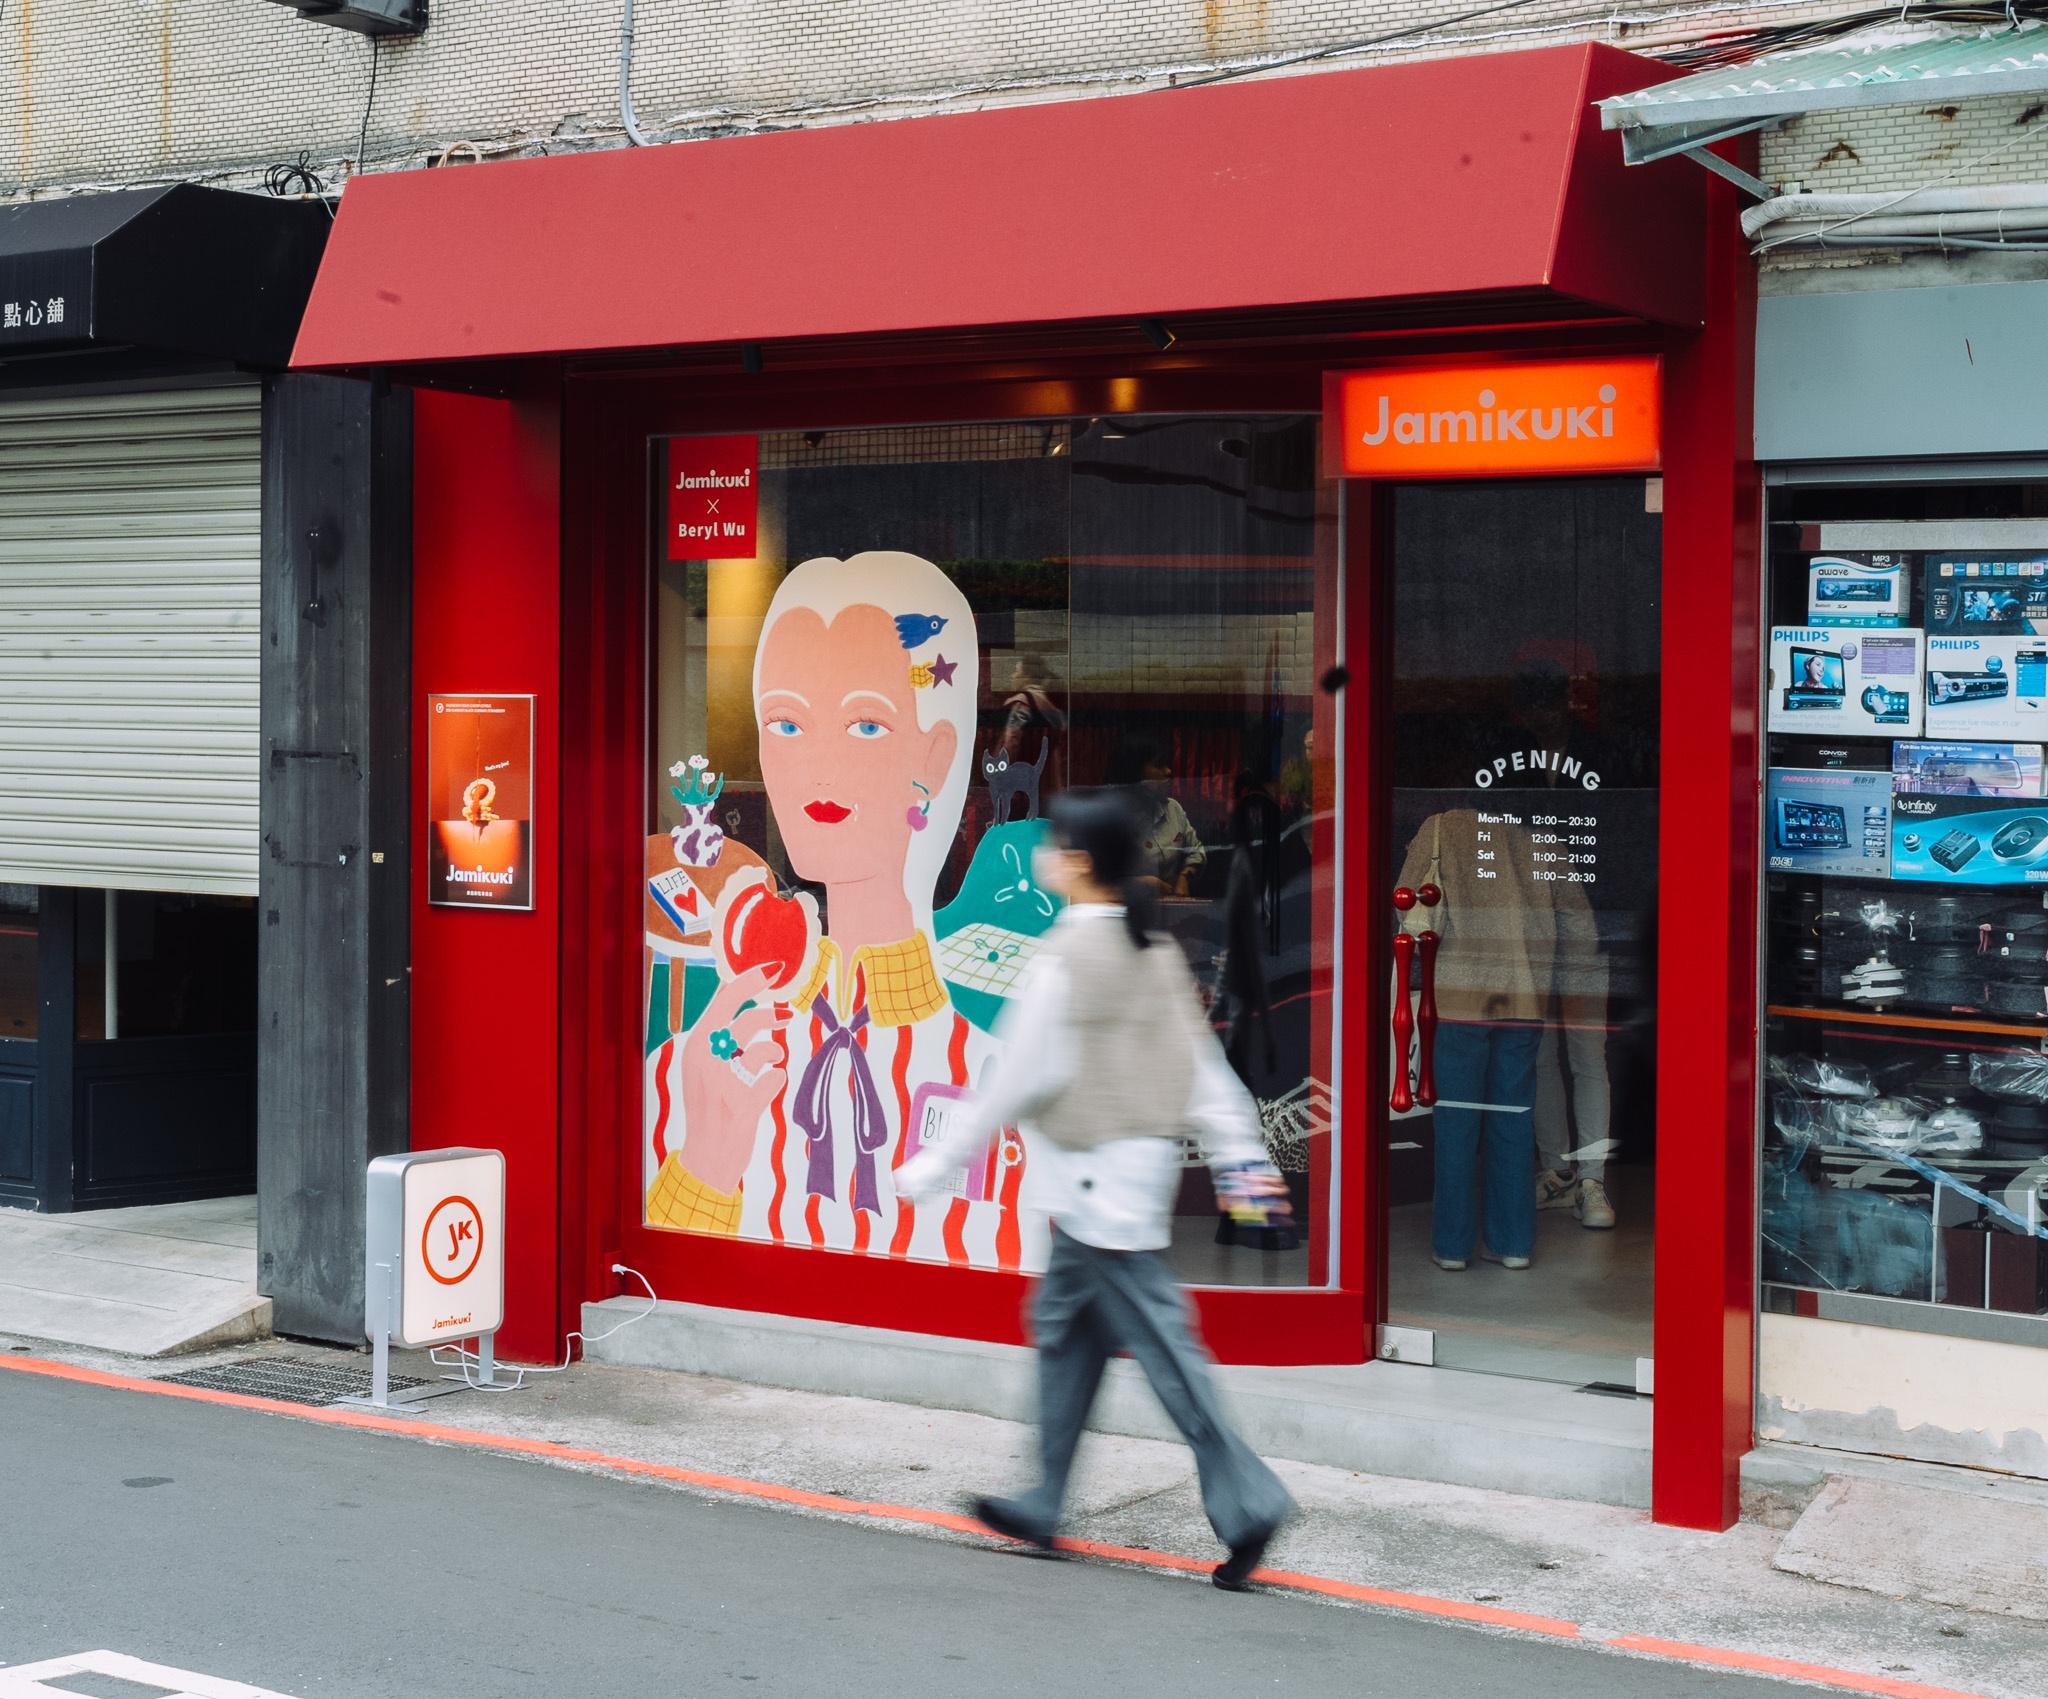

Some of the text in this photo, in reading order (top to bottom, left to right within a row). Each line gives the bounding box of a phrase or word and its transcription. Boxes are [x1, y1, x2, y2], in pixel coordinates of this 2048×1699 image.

[3, 296, 65, 328] 點心舖
[1362, 383, 1617, 446] Jamikuki
[675, 468, 751, 490] Jamikuki
[678, 521, 745, 540] Beryl Wu
[1872, 555, 1890, 563] MP3
[1818, 568, 1849, 576] awave
[1773, 630, 1830, 643] PHILIPS
[1931, 640, 1980, 650] PHILIPS
[1475, 749, 1601, 791] OPENING
[1781, 775, 1852, 785] INNOVATIVE
[1477, 813, 1522, 825] Mon-Thu
[1477, 831, 1491, 842] Fri
[1477, 849, 1495, 860] Sat
[445, 864, 514, 885] Jamikuki
[1477, 868, 1497, 879] Sun
[656, 870, 689, 895] LIFE
[447, 1219, 473, 1262] JK
[431, 1312, 472, 1330] Jamikuki
